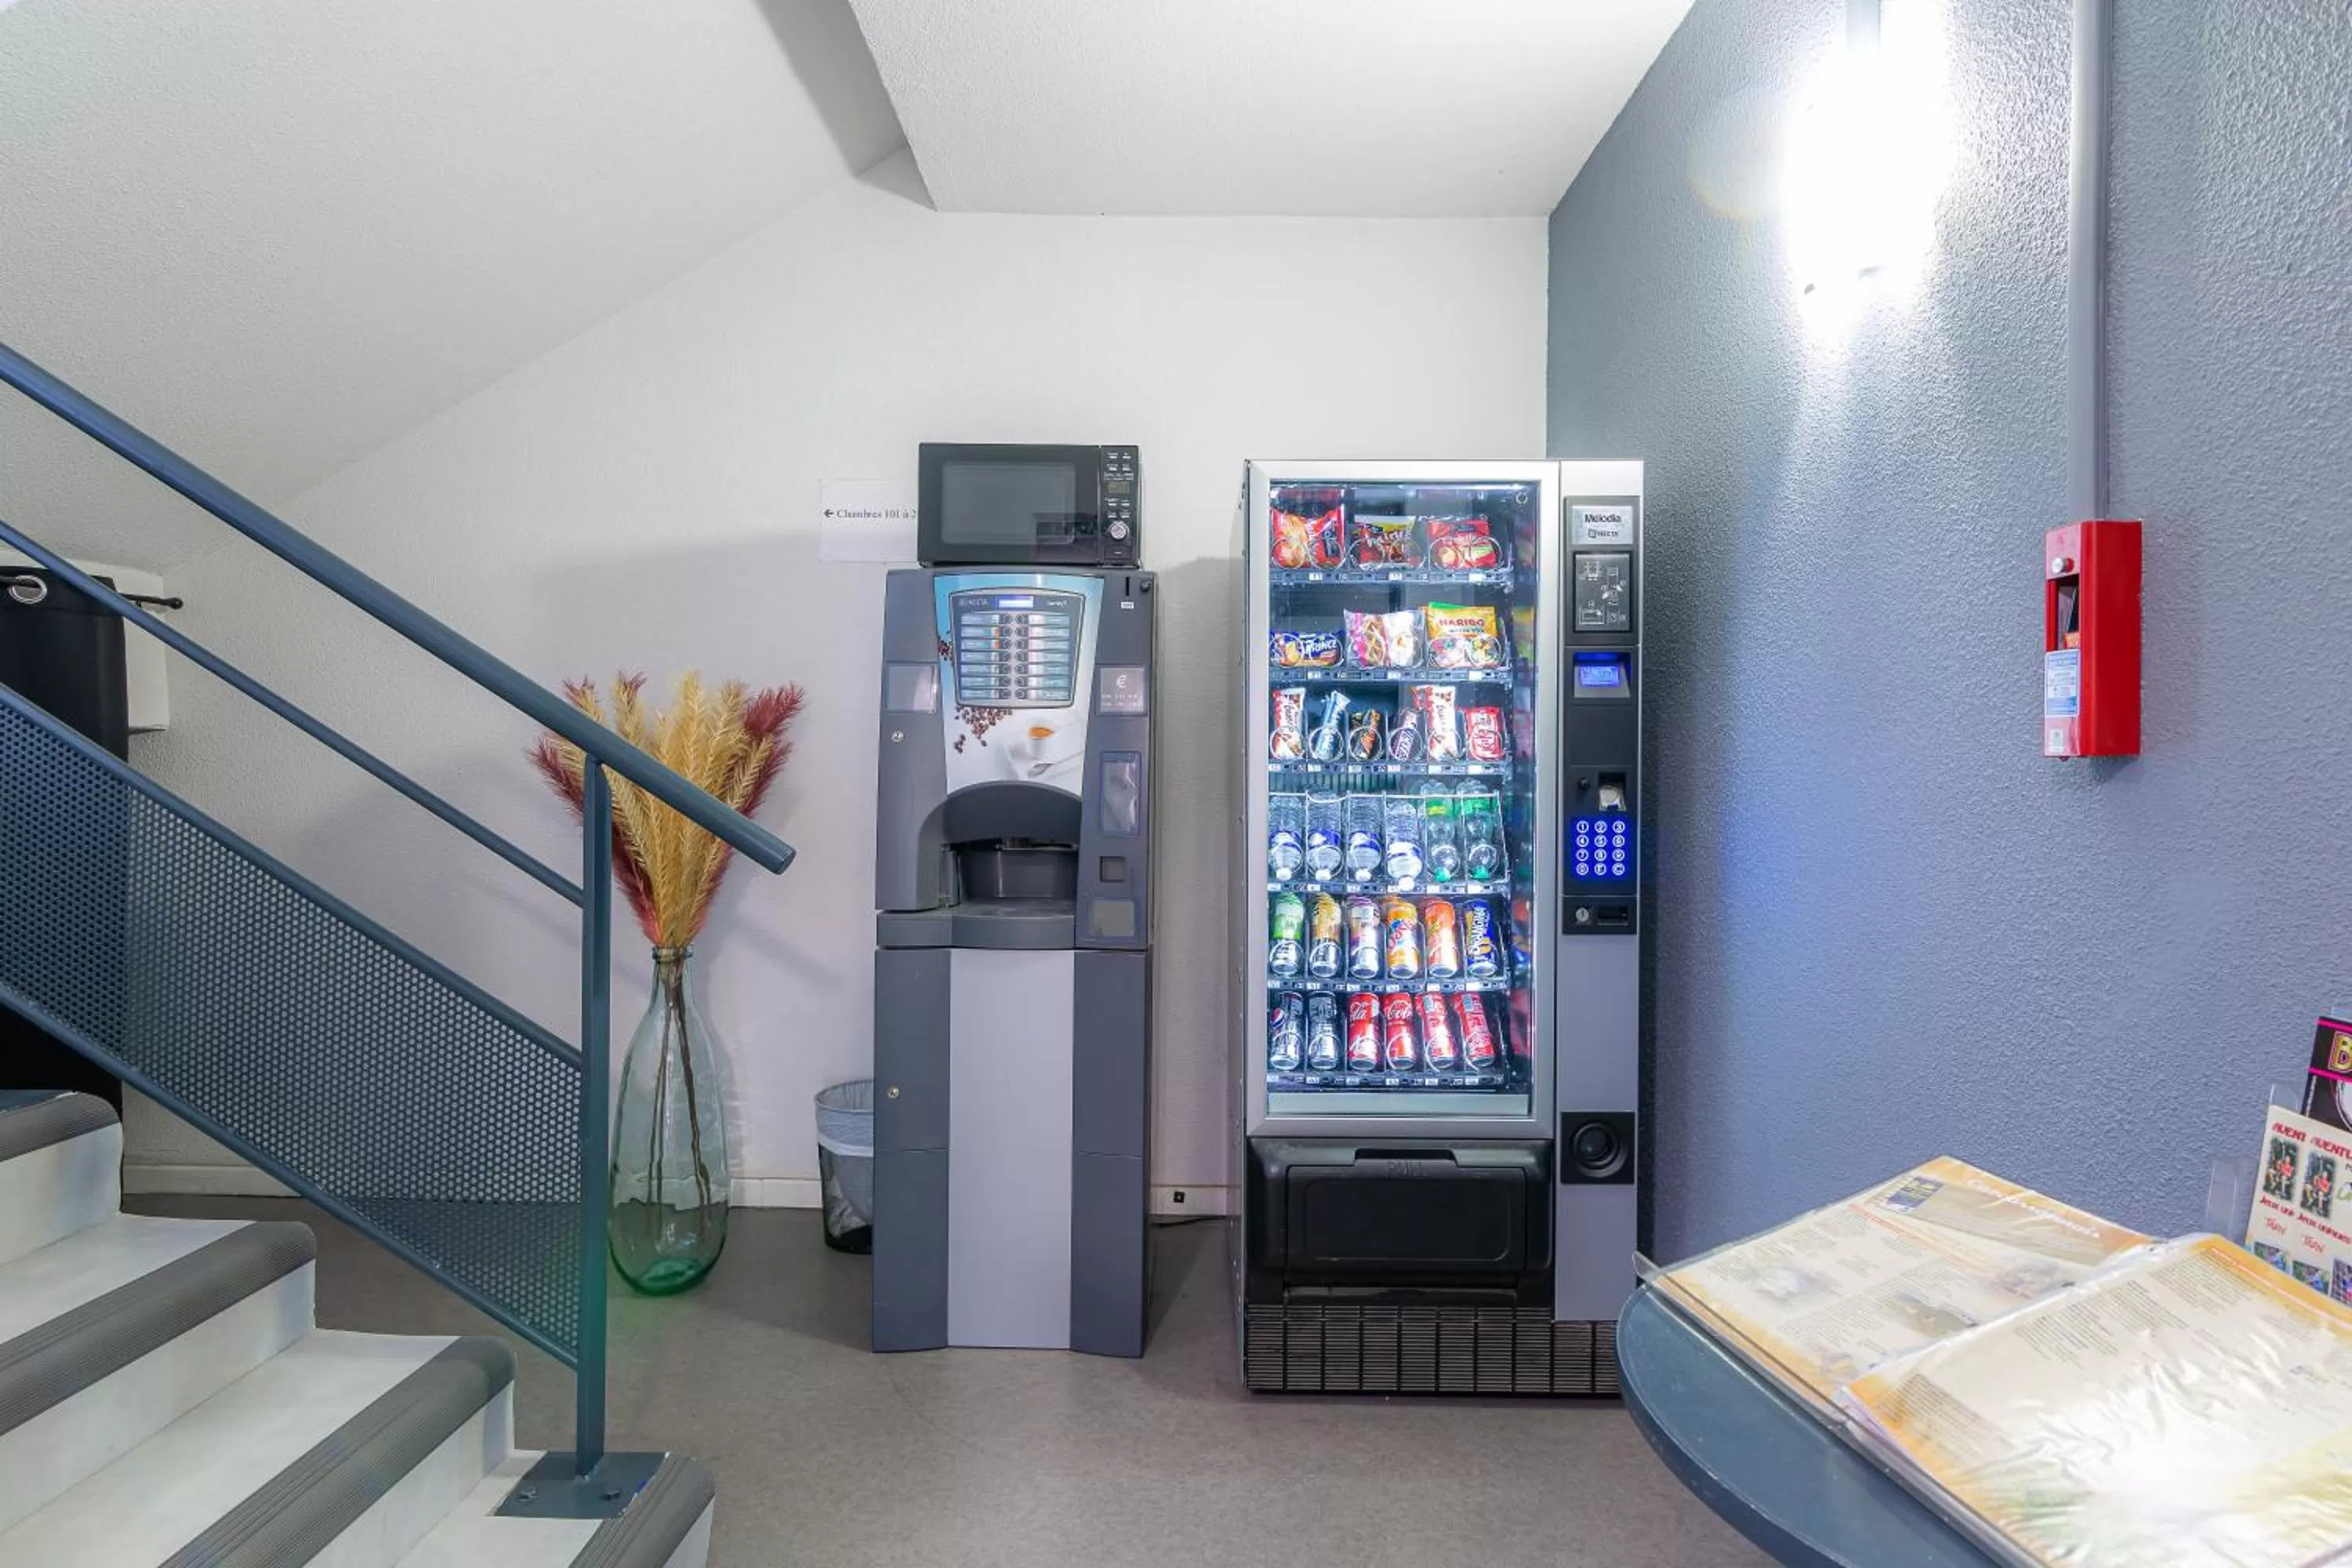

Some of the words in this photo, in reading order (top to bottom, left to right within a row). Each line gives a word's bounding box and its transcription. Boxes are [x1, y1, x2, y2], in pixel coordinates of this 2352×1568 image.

[836, 508, 882, 519] Chambres
[884, 508, 900, 519] 101
[1439, 618, 1485, 626] HARIBO
